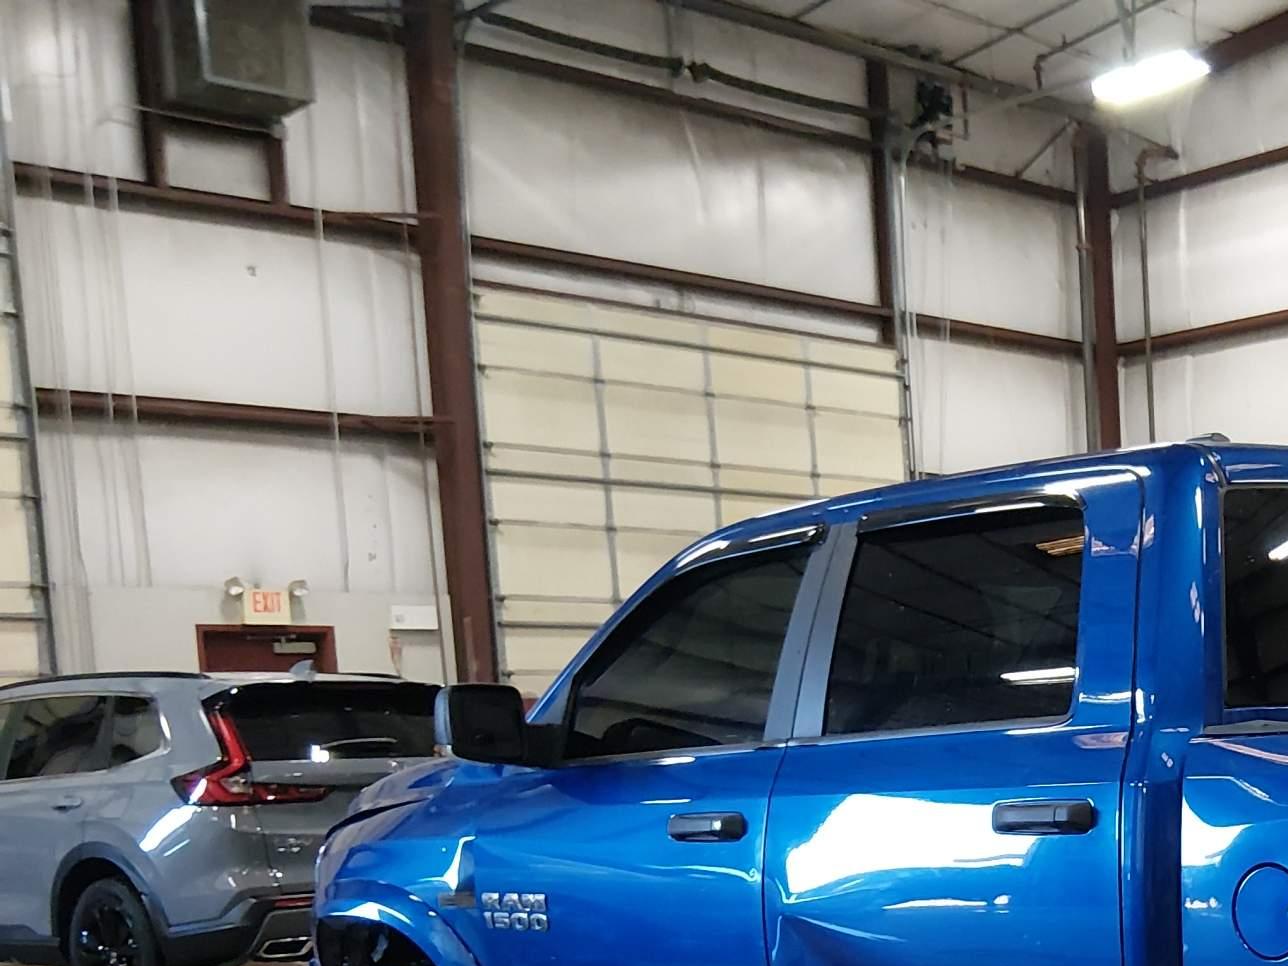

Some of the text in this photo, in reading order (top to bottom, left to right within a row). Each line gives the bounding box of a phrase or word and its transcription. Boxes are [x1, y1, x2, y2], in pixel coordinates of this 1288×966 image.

[252, 591, 282, 613] EXIT
[481, 892, 547, 912] RAM
[483, 911, 549, 931] 1500
